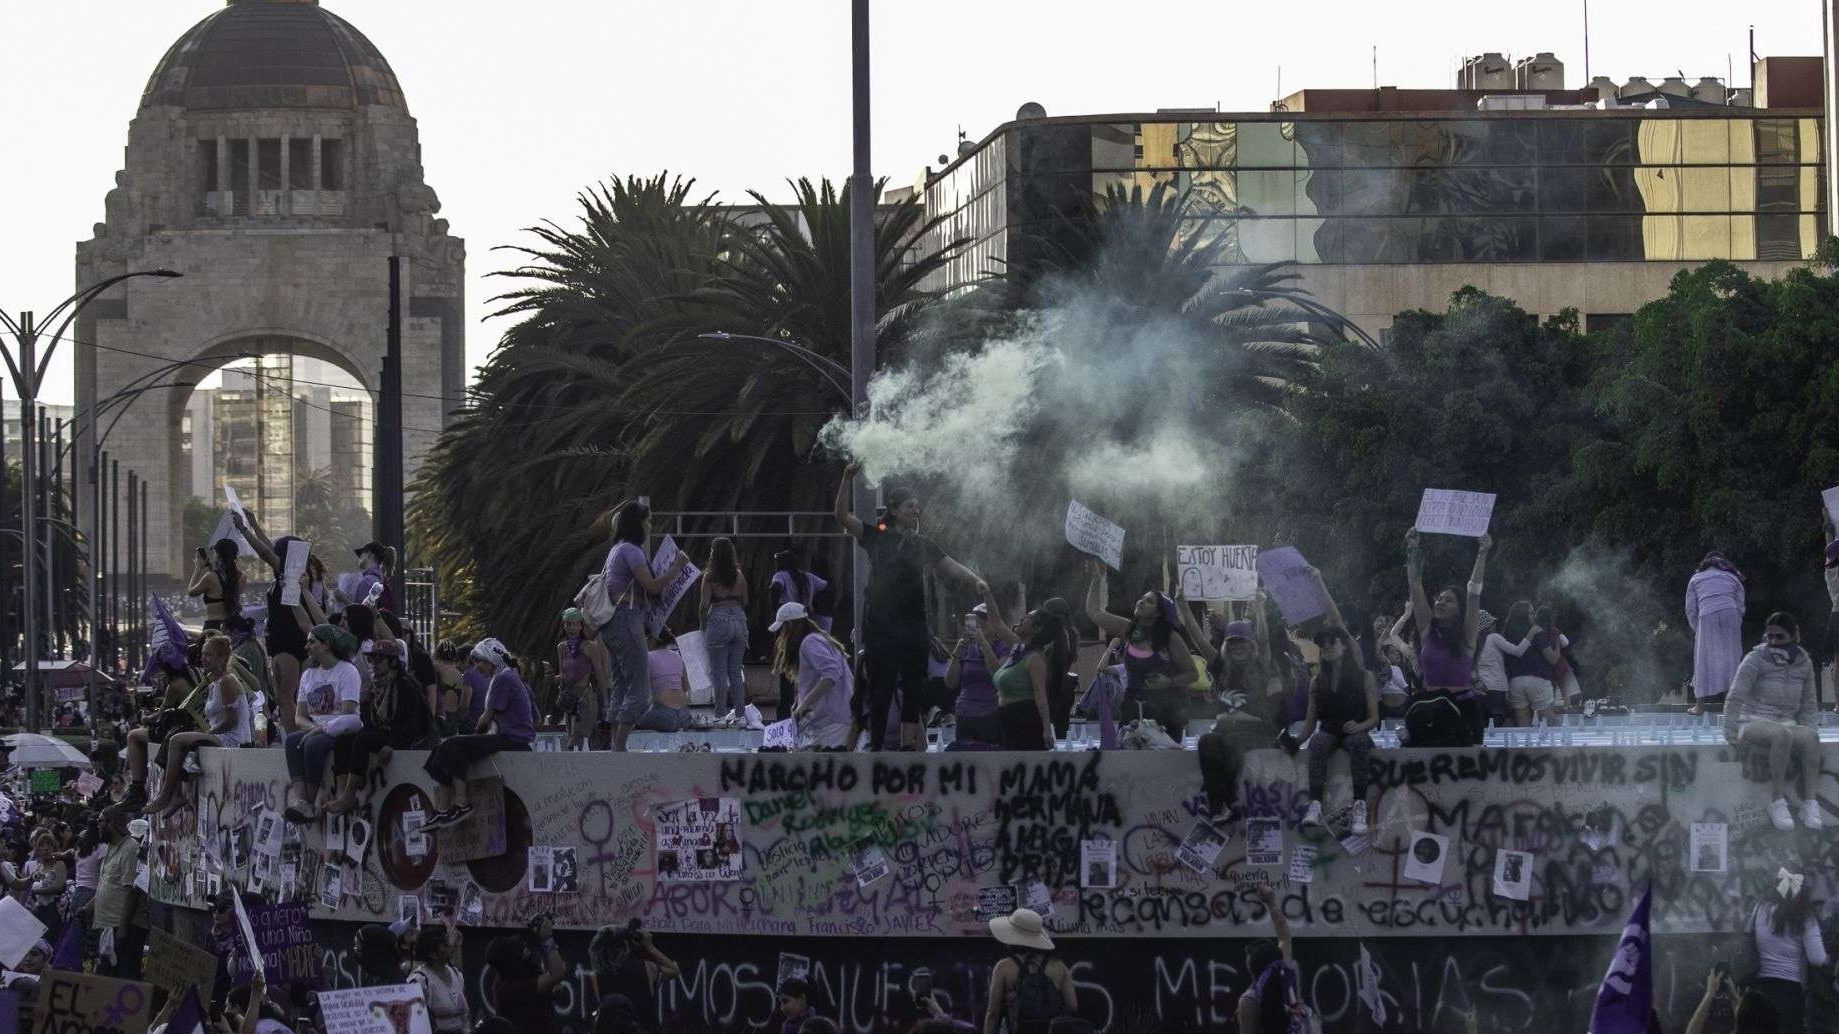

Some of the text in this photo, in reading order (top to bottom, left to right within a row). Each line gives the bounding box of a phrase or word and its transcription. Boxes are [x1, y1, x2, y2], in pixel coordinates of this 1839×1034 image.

[1178, 547, 1216, 566] ESTOY
[871, 760, 925, 795] POR
[939, 761, 978, 796] MI
[1281, 885, 1341, 926] de
[49, 980, 87, 1019] EL
